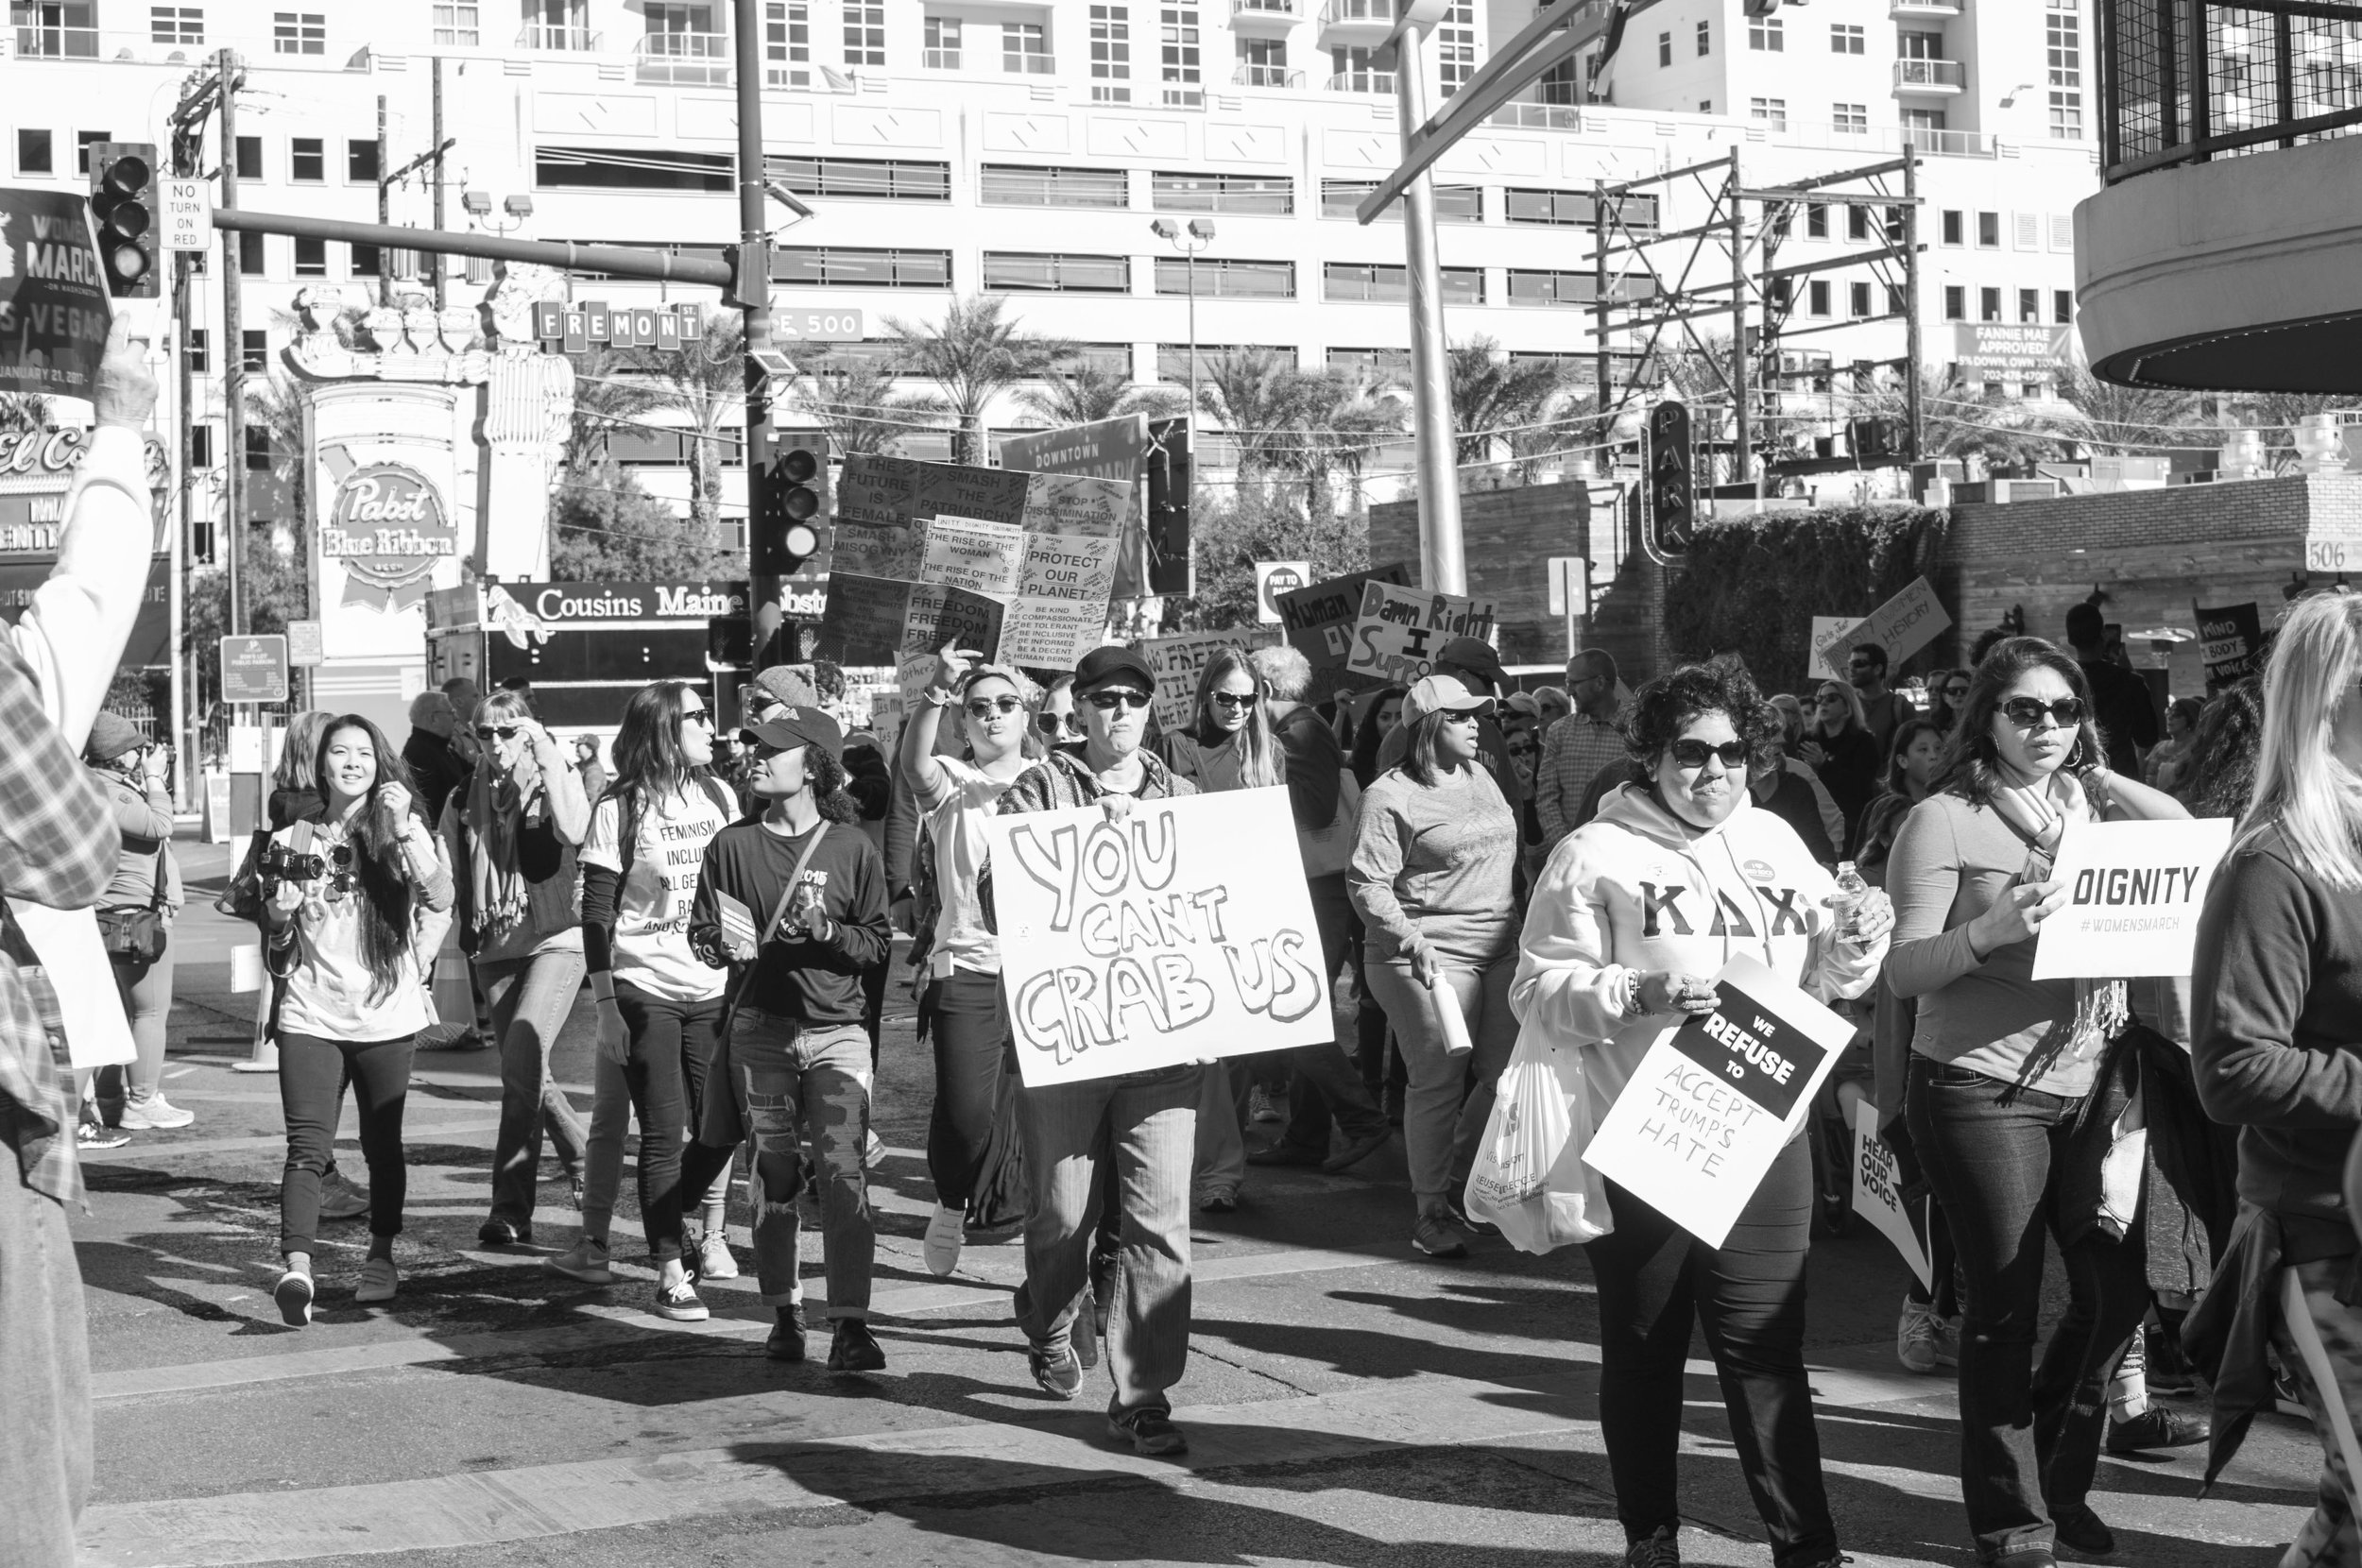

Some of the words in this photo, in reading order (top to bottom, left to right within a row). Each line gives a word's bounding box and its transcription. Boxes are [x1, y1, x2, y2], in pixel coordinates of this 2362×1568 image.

[173, 185, 196, 198] NO
[169, 202, 200, 213] TURN
[177, 218, 194, 229] ON
[174, 233, 197, 246] RED
[682, 307, 696, 315] ST.
[545, 313, 696, 338] FREMONT
[807, 315, 856, 333] 500
[1976, 327, 2022, 340] FANNIE
[2023, 329, 2050, 341] MAE
[1978, 341, 2048, 354] APPROVED!
[2009, 357, 2035, 367] OWN
[866, 458, 898, 473] THE
[1036, 443, 1099, 469] DOWNTOWN
[847, 472, 910, 491] FUTURE
[946, 471, 1001, 488] SMASH
[1659, 410, 1686, 546] PARK
[346, 477, 430, 522] Pabst
[868, 492, 884, 504] IS
[956, 488, 986, 503] THE
[1058, 496, 1088, 506] STOP
[841, 505, 906, 525] FEMALE
[919, 499, 1015, 523] PATRIARCHY
[1023, 505, 1118, 521] DISCRIMINATION
[323, 528, 374, 557] Blue
[374, 528, 454, 557] Ribbon
[847, 528, 898, 542] SMASH
[929, 532, 950, 542] THE
[951, 536, 976, 546] RISE
[978, 539, 992, 549] OF
[996, 542, 1016, 552] THE
[834, 541, 908, 557] MISOGYNY
[950, 546, 991, 558] WOMAN
[2309, 541, 2346, 569] 506
[1029, 551, 1103, 569] PROTECT
[924, 563, 943, 572] THE
[946, 566, 970, 575] RISE
[971, 570, 986, 579] OF
[988, 573, 1009, 583] THE
[945, 576, 983, 589] NATION
[1045, 569, 1079, 583] OUR
[1269, 574, 1285, 586] PAY
[1285, 574, 1298, 586] TO
[1027, 584, 1089, 600] PLANET
[536, 588, 643, 622] Cousins
[654, 586, 744, 617] Maine
[911, 596, 990, 620] FREEDOM
[1361, 583, 1421, 627] Damn
[1427, 594, 1495, 639] Right
[909, 612, 988, 635] FREEDOM
[1021, 614, 1093, 623] COMPASSIONATE
[1881, 600, 1931, 645] HISTORY
[907, 628, 984, 649] FREEOM
[1032, 630, 1077, 639] INCLUSIVE
[2201, 620, 2236, 638] MIND
[1031, 639, 1075, 647] INFORMED
[1401, 627, 1431, 658] I
[2209, 639, 2238, 658] BODY
[1013, 653, 1045, 662] HUMAN
[1351, 624, 1435, 684] Suppo
[2216, 656, 2250, 676] VOICE
[659, 819, 717, 842] FEMINISM
[666, 846, 706, 866] INCLU
[1009, 810, 1177, 932] YOU
[659, 876, 679, 892] ALL
[2072, 866, 2200, 905] DIGNITY
[2080, 915, 2181, 933] #WOMENSMARCH
[1014, 953, 1215, 1065] GRAB
[1221, 928, 1322, 1023] US
[1752, 1014, 1776, 1038] WE
[1702, 1012, 1795, 1085] REFUSE
[1725, 1059, 1745, 1079] TO
[1664, 1064, 1765, 1127] ACCEPT
[1655, 1089, 1736, 1149] TRUMP'S
[1637, 1118, 1725, 1179] HATE
[1862, 1133, 1892, 1173] HEAR
[1861, 1152, 1888, 1185] OUR
[1859, 1167, 1897, 1213] VOICE
